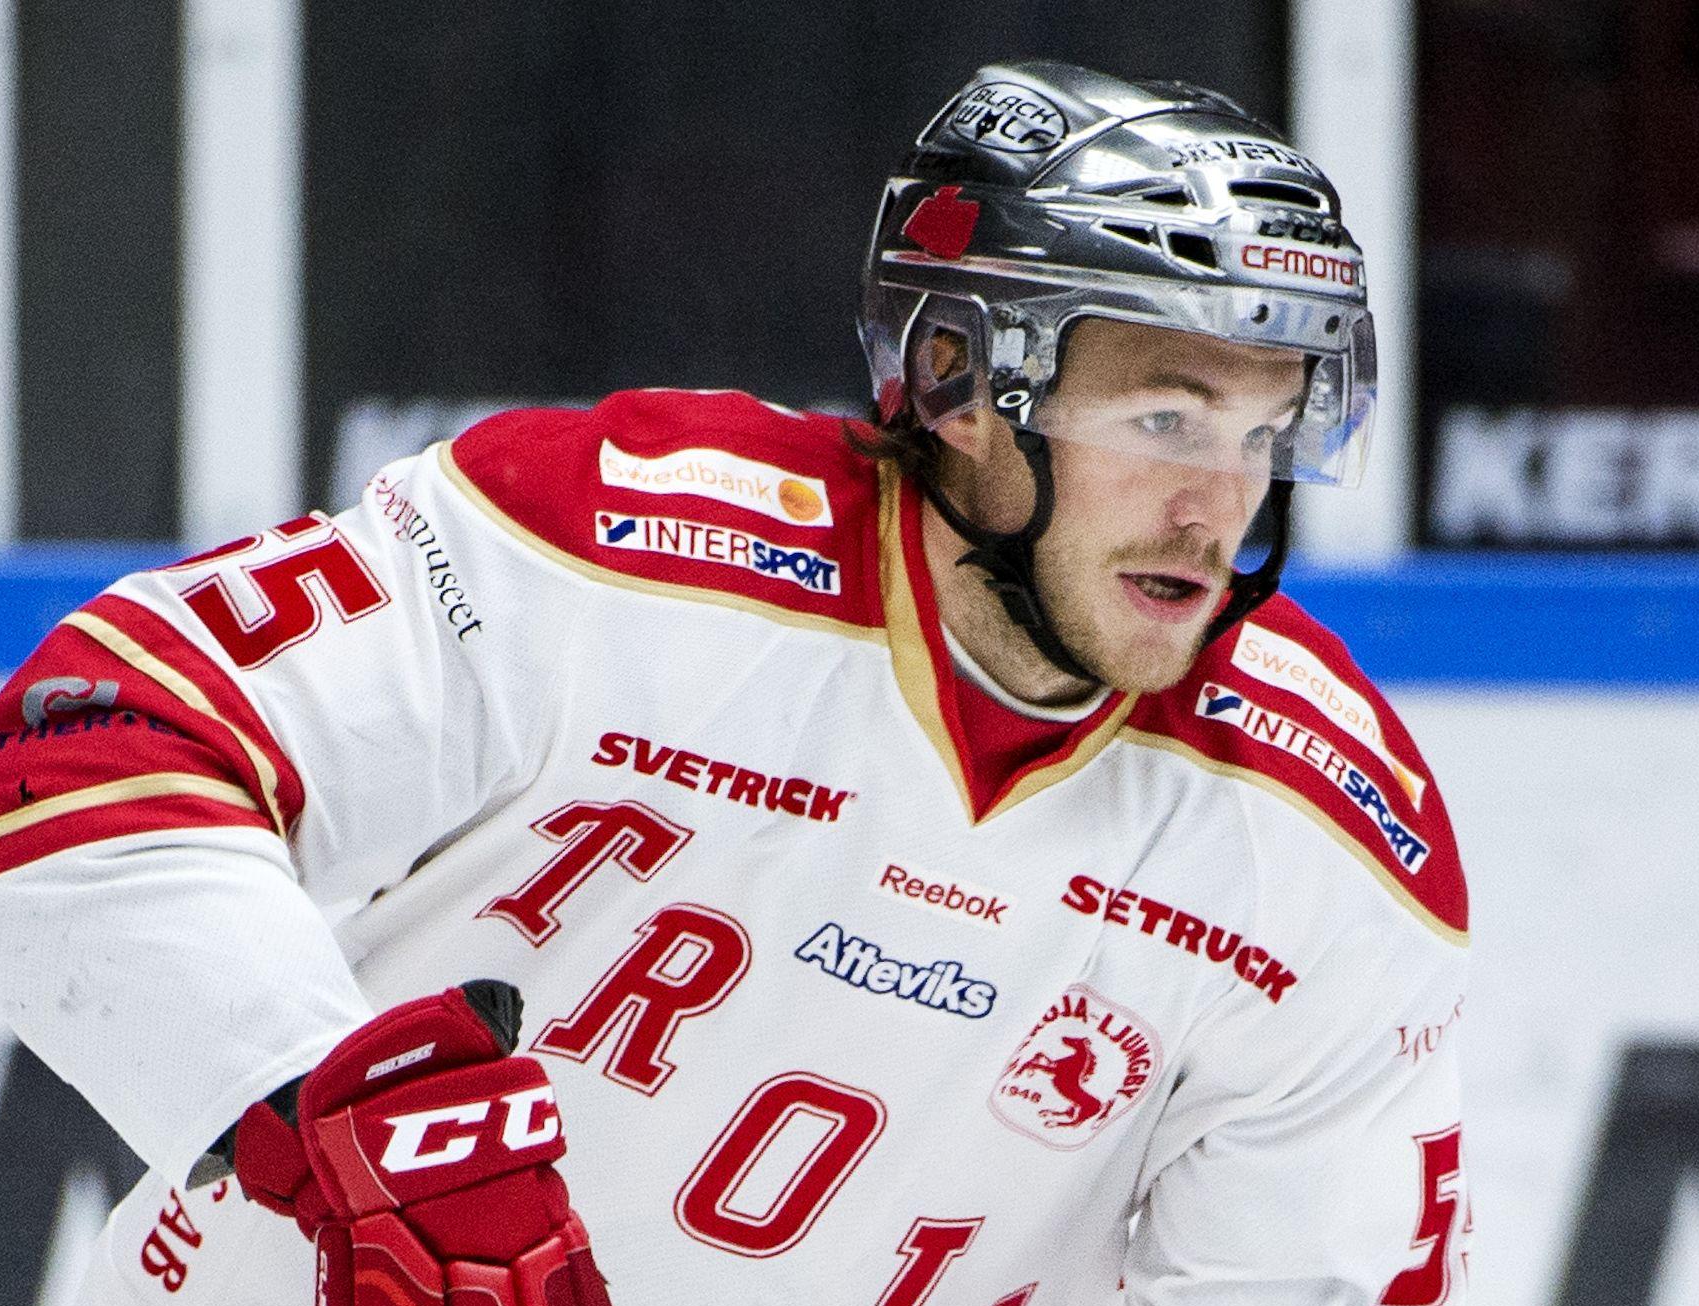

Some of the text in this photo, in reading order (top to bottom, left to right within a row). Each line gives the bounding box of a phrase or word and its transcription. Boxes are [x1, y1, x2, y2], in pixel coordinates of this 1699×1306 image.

[972, 87, 1057, 125] BLACK
[1241, 244, 1354, 286] CFMOTO
[644, 518, 838, 592] INTERSPORT
[1242, 706, 1428, 868] INTERSPORT
[879, 863, 1009, 925] Reebok
[794, 922, 997, 1020] Atteviks
